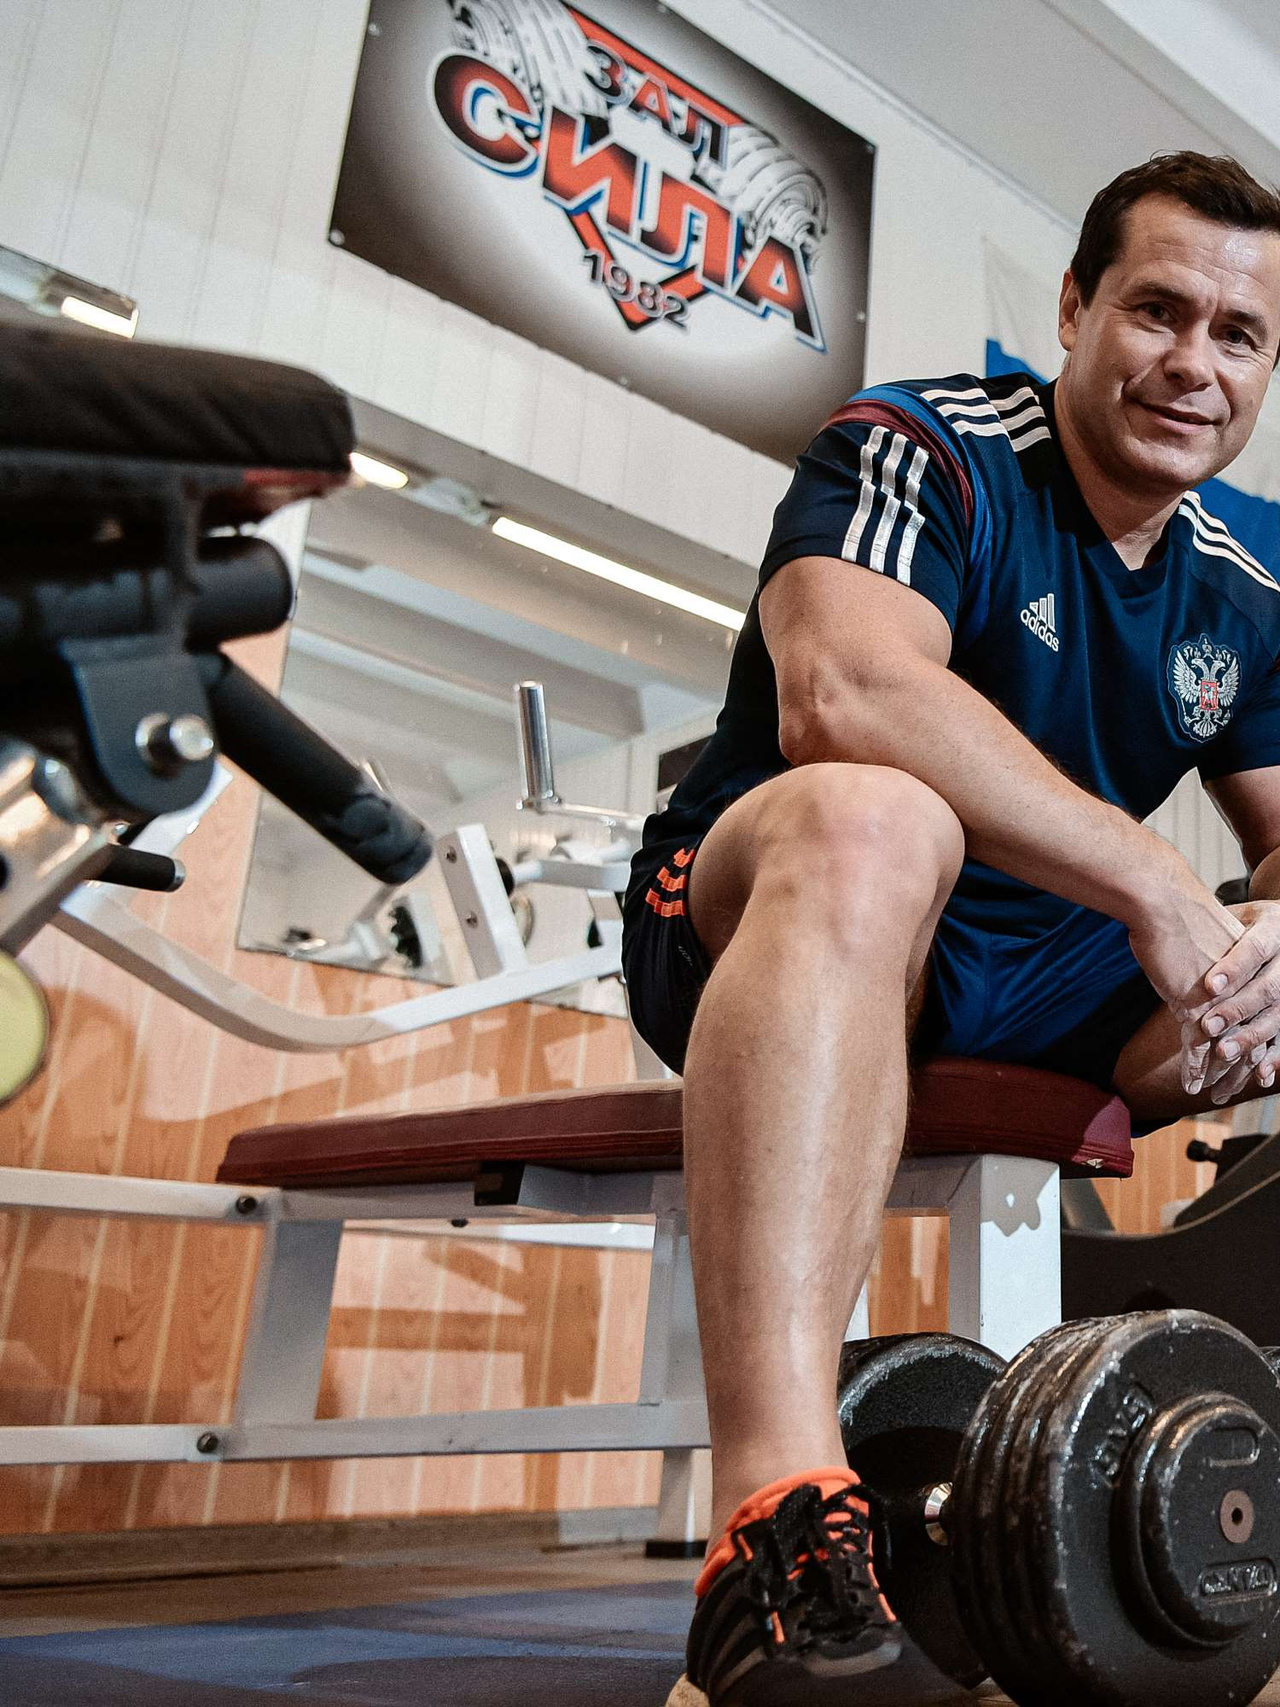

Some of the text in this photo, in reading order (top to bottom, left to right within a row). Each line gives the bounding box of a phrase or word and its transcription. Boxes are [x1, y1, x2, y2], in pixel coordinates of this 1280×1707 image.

[585, 41, 728, 167] ЗАЛ
[431, 49, 828, 353] СИЛА
[582, 250, 691, 331] 1982
[1020, 608, 1060, 652] adidas
